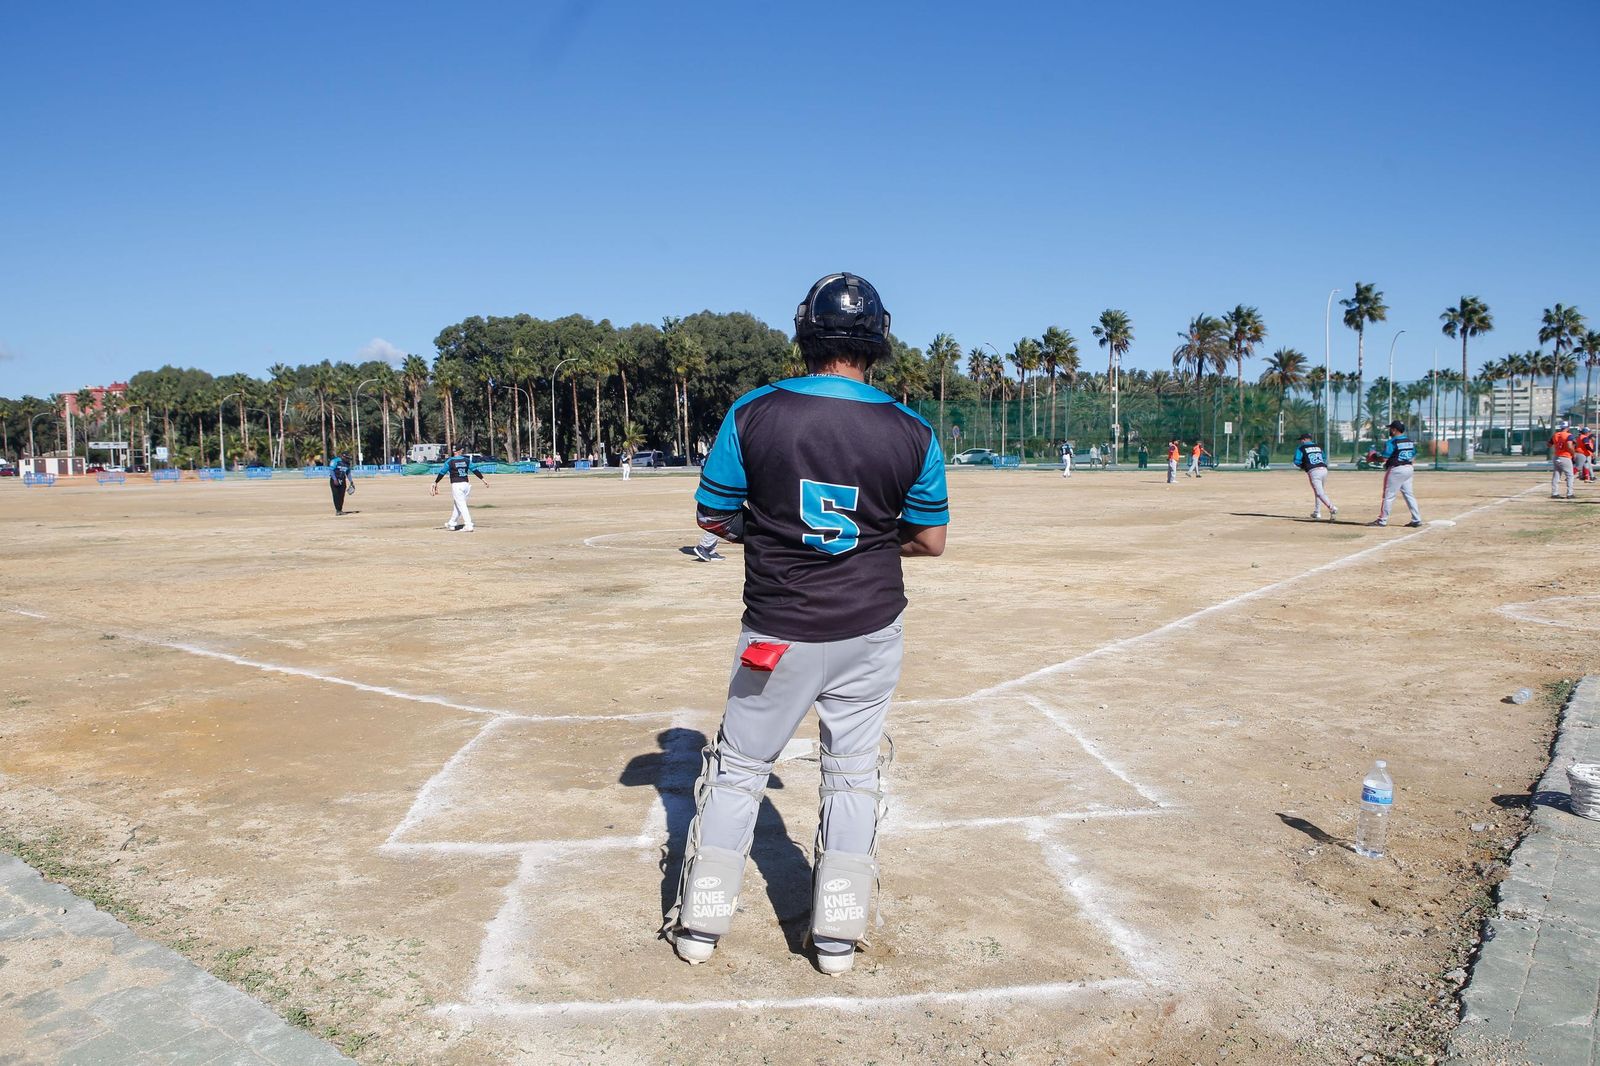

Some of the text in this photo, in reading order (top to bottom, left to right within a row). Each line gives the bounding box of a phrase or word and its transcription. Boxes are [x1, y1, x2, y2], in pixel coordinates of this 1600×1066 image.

[800, 479, 860, 555] 5
[693, 890, 725, 904] KNEE
[823, 893, 857, 909] KNEE
[693, 904, 731, 918] SAVER
[825, 906, 864, 922] SAVER
